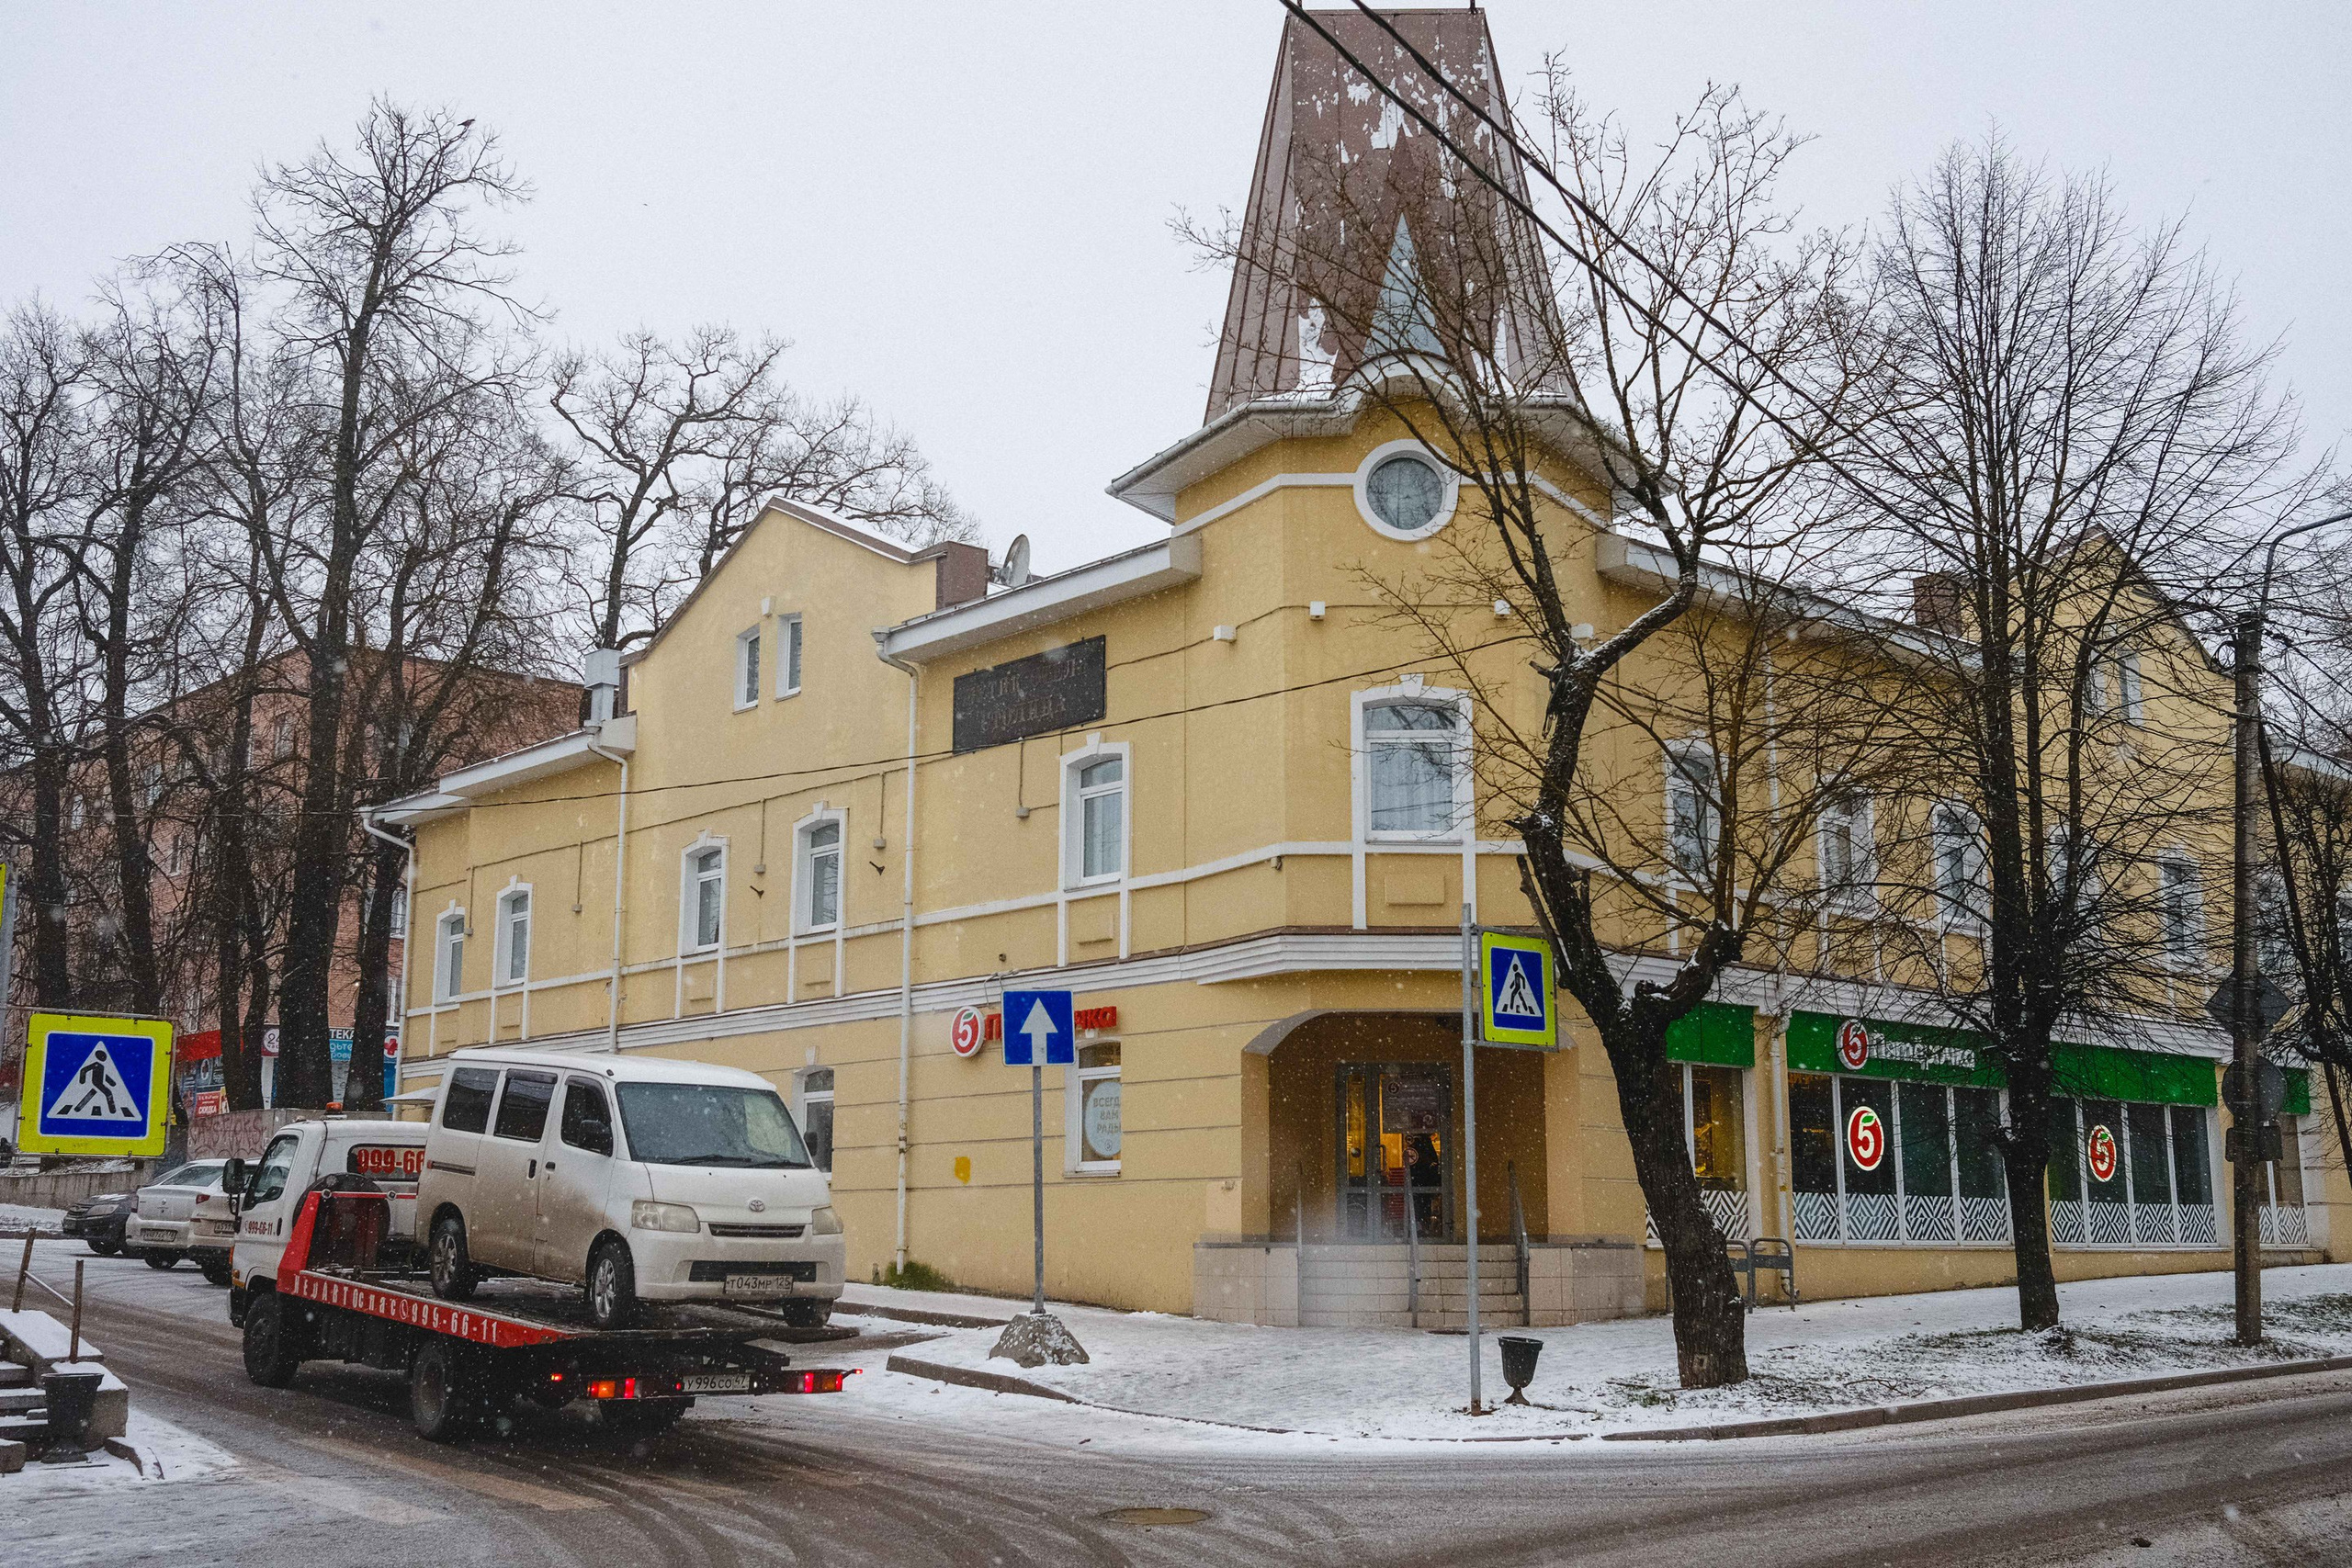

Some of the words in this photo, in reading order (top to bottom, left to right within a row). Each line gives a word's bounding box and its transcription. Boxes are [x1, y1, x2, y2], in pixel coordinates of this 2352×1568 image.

[1093, 1097, 1120, 1108] ВСЕГД
[1100, 1110, 1119, 1121] ВАМ
[248, 1221, 274, 1235] 999-66-11
[775, 1277, 790, 1287] 125
[687, 1376, 732, 1390] У996СО
[735, 1376, 747, 1385] 47
